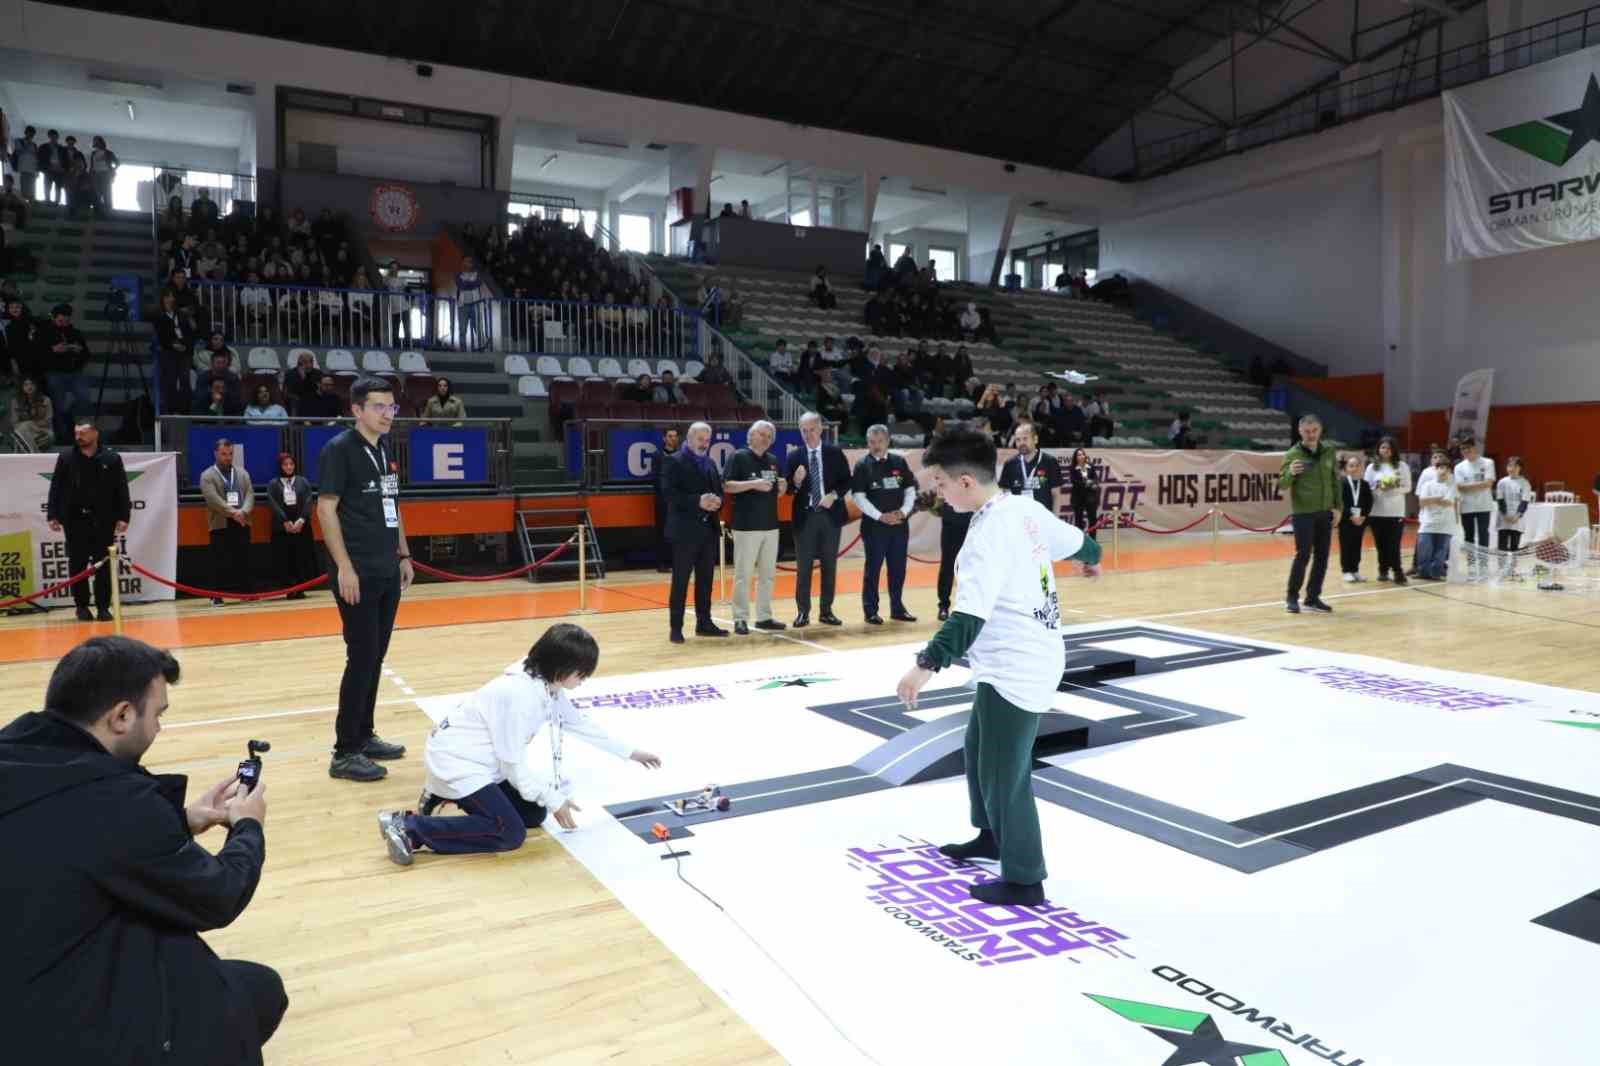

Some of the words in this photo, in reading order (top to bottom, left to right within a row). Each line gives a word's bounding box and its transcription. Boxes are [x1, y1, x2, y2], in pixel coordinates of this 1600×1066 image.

[433, 443, 465, 480] E
[627, 441, 657, 477] G
[1158, 473, 1198, 508] HOŞ
[847, 848, 1090, 956] ROBOT
[884, 906, 982, 962] STARWOOD
